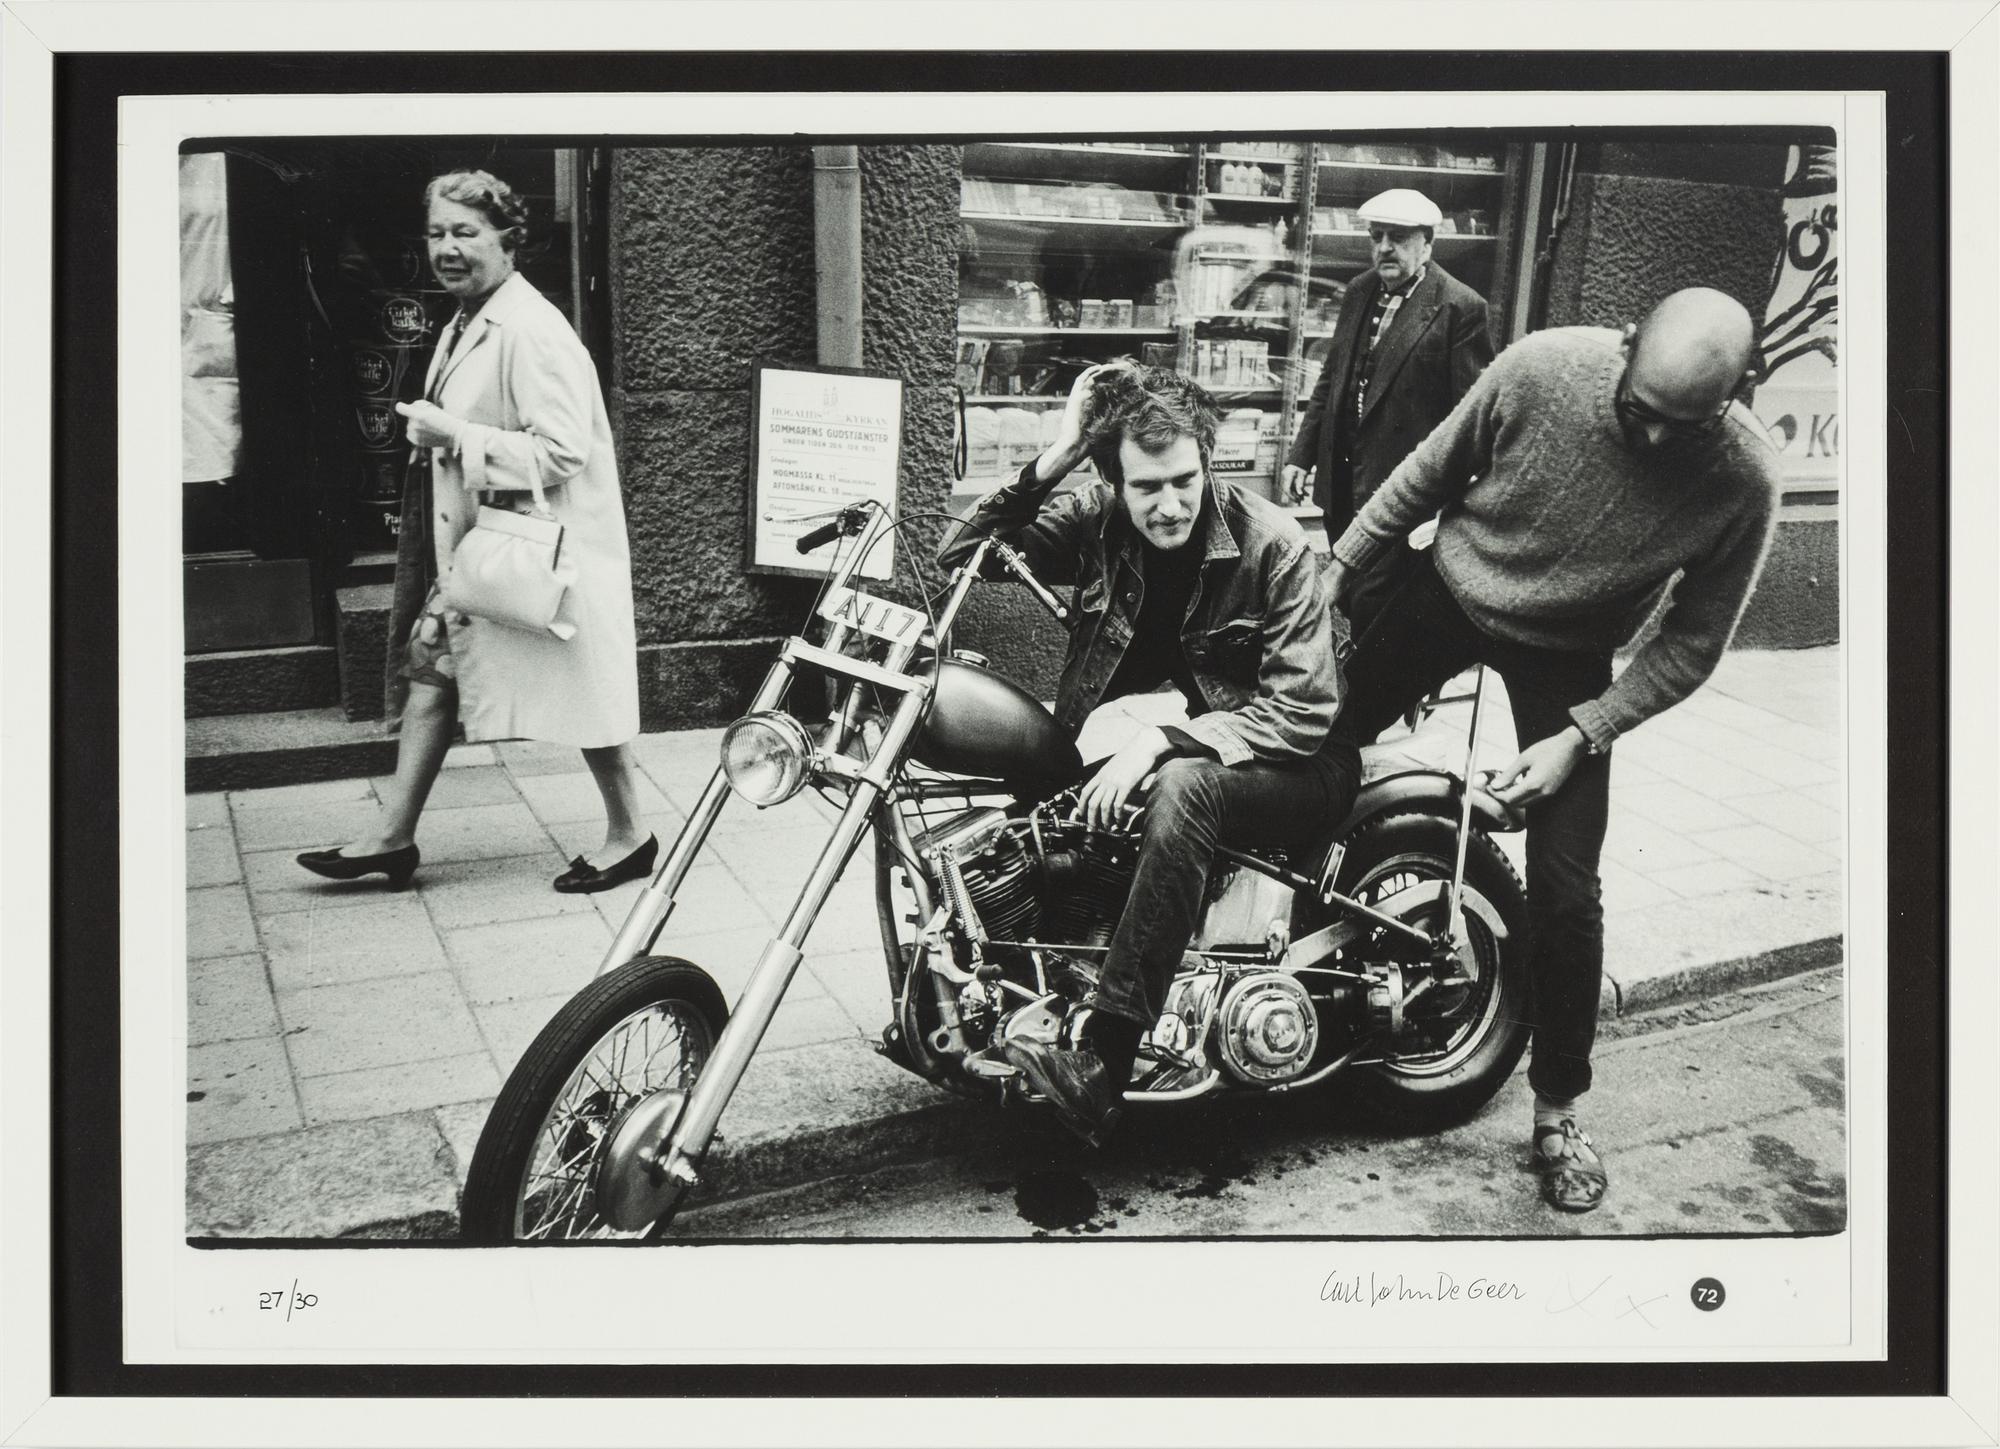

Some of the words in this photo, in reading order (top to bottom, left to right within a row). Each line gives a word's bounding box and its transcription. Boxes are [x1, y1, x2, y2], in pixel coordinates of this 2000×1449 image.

[391, 315, 419, 328] kaffe
[845, 415, 888, 426] KYRKAN
[769, 423, 824, 438] SOMMARENS
[833, 594, 917, 638] A117
[1436, 1270, 1461, 1302] De
[1467, 1277, 1528, 1300] Geer
[259, 1277, 319, 1323] 27/30
[1698, 1287, 1718, 1303] 72
